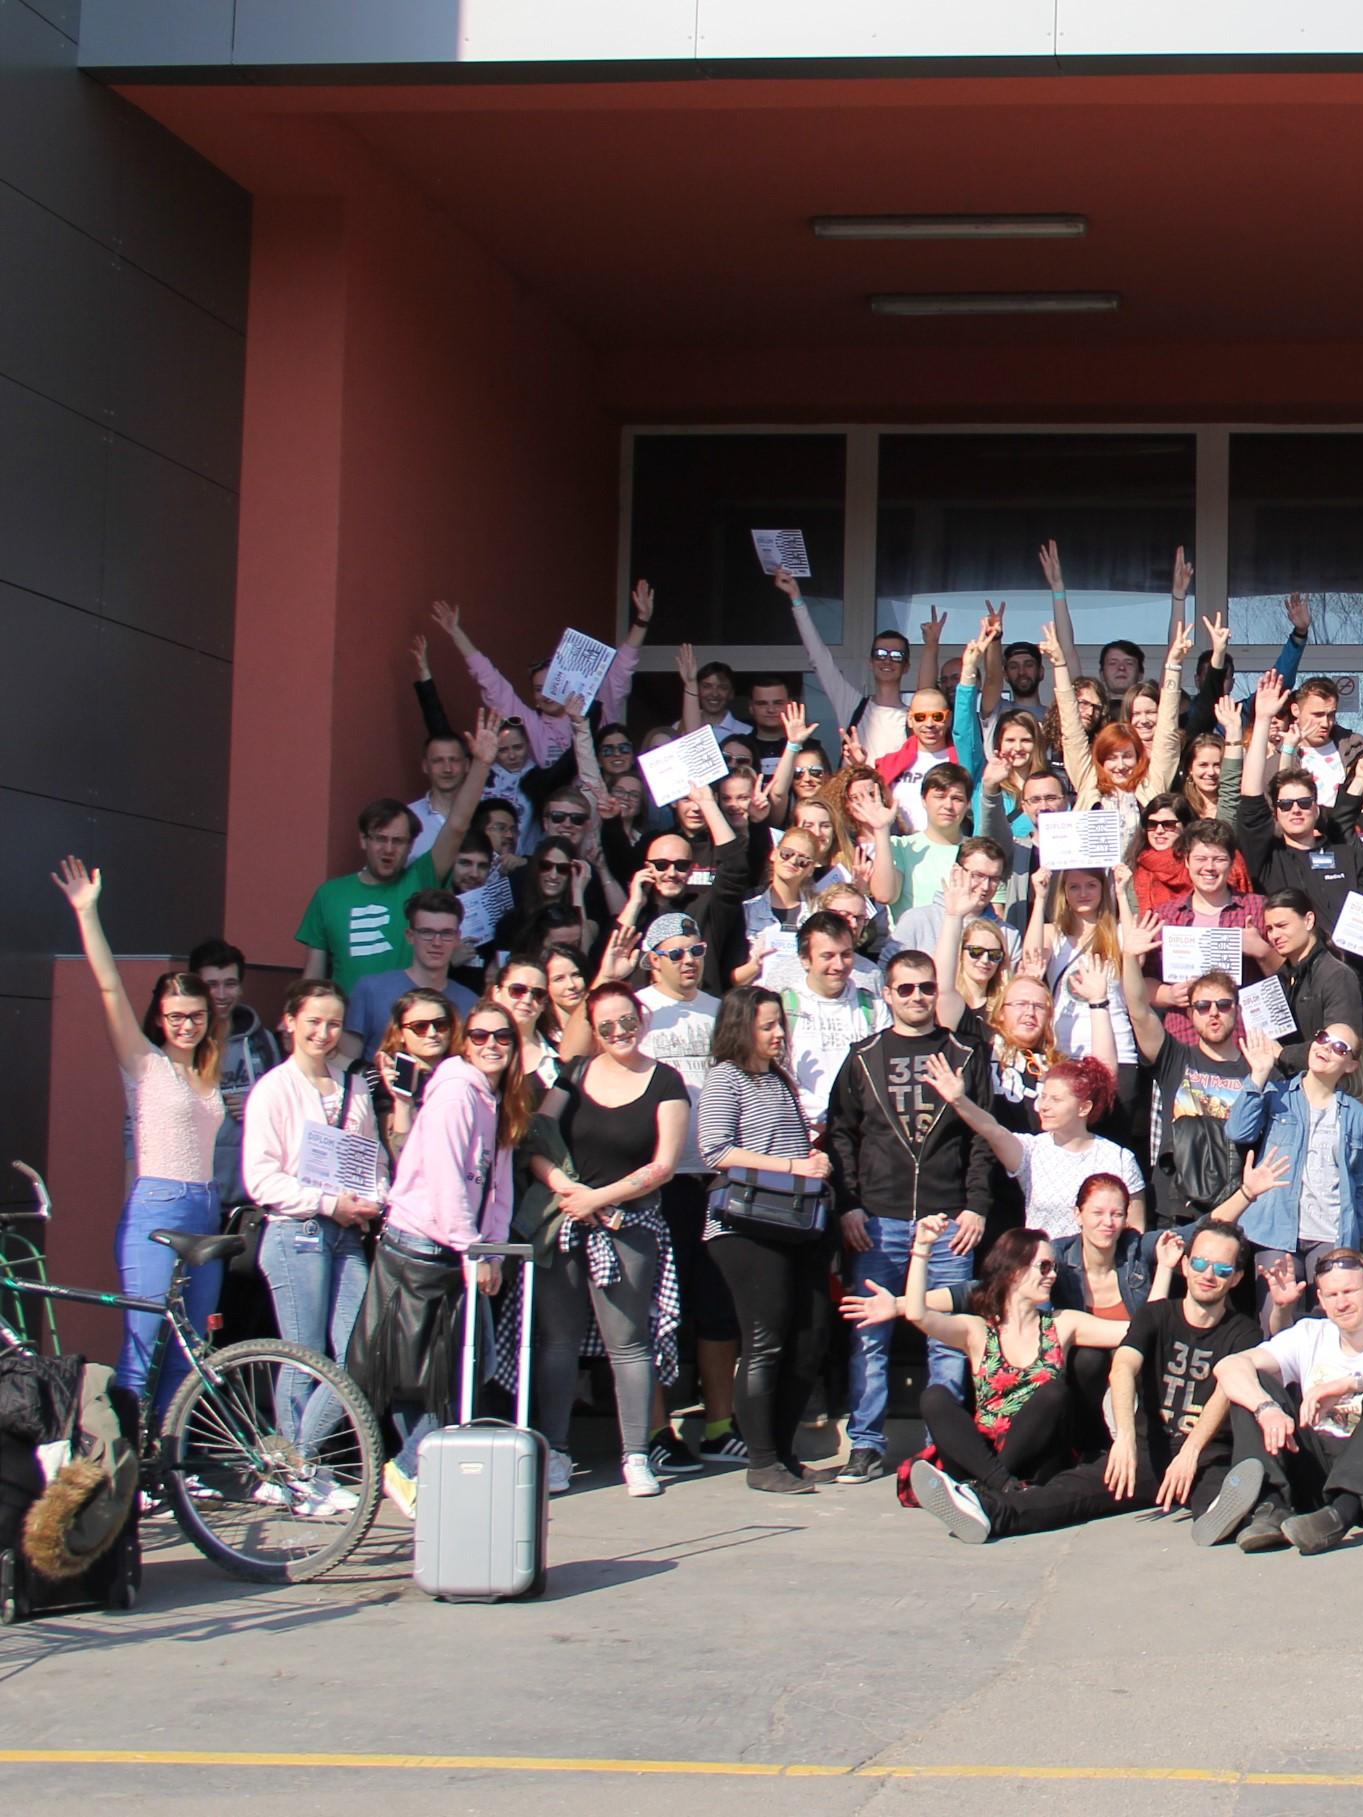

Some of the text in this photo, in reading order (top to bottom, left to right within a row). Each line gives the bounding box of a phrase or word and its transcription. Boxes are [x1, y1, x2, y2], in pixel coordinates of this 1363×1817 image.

[1168, 936, 1196, 944] DIPLOM
[888, 1084, 935, 1113] TL
[1168, 1341, 1213, 1380] 35
[1162, 1374, 1203, 1414] TL
